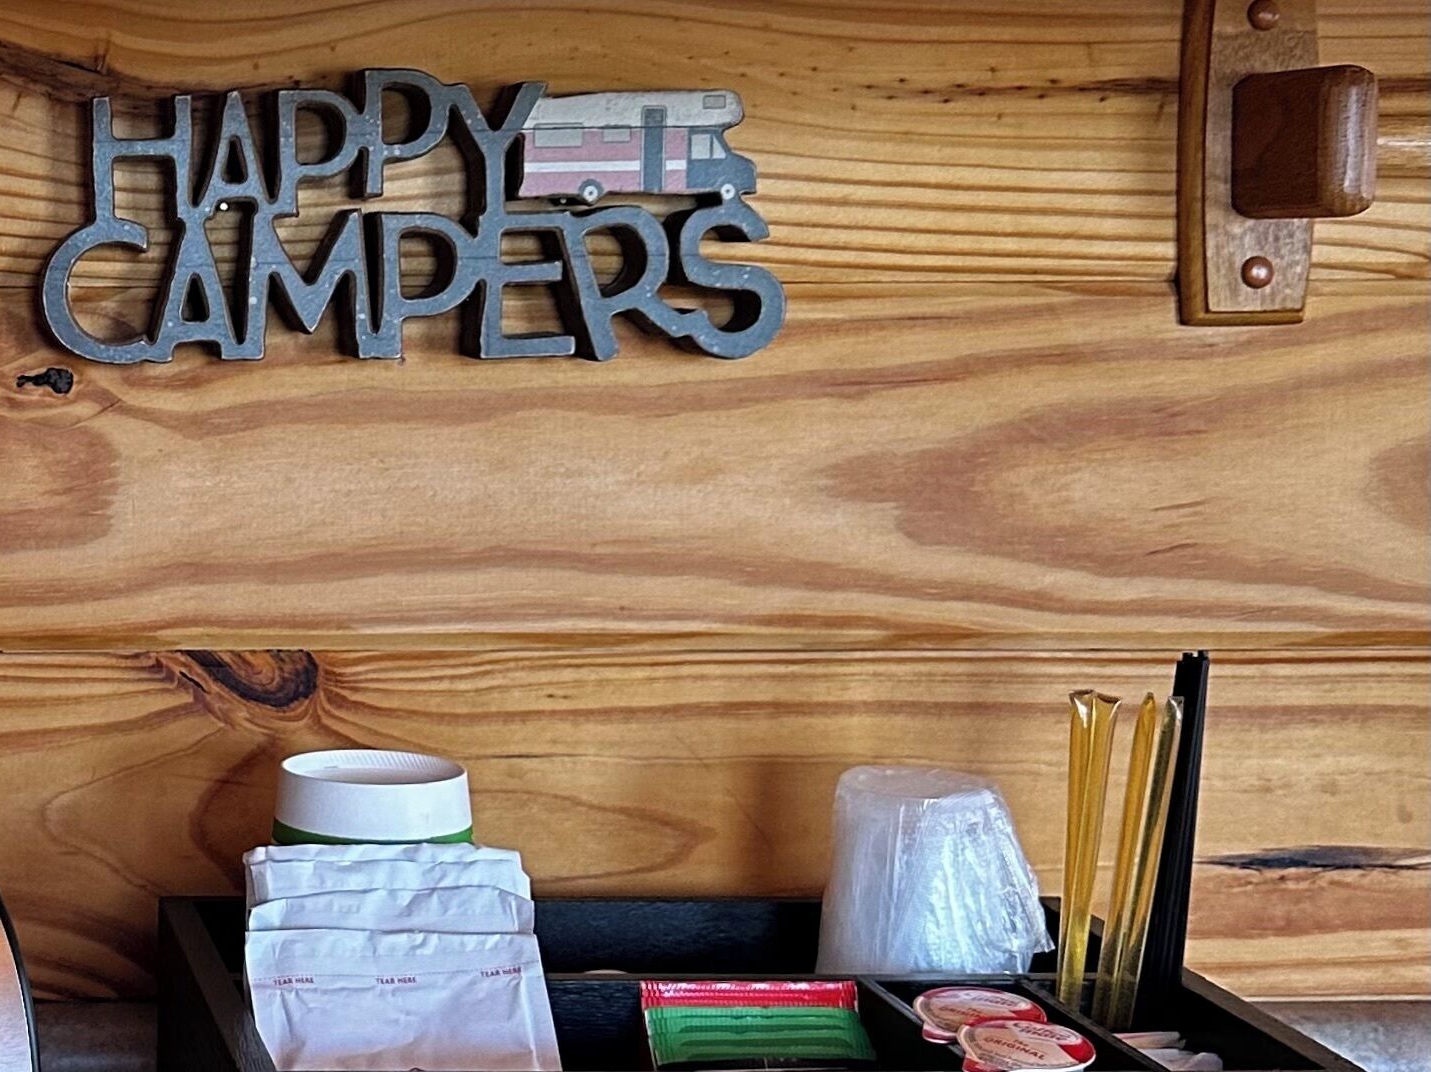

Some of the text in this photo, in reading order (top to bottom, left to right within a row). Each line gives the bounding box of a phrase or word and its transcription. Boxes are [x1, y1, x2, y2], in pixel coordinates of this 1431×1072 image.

[93, 68, 549, 224] HAPPY
[41, 202, 788, 363] CAMPERS
[983, 1037, 1045, 1060] ORIGINAL
